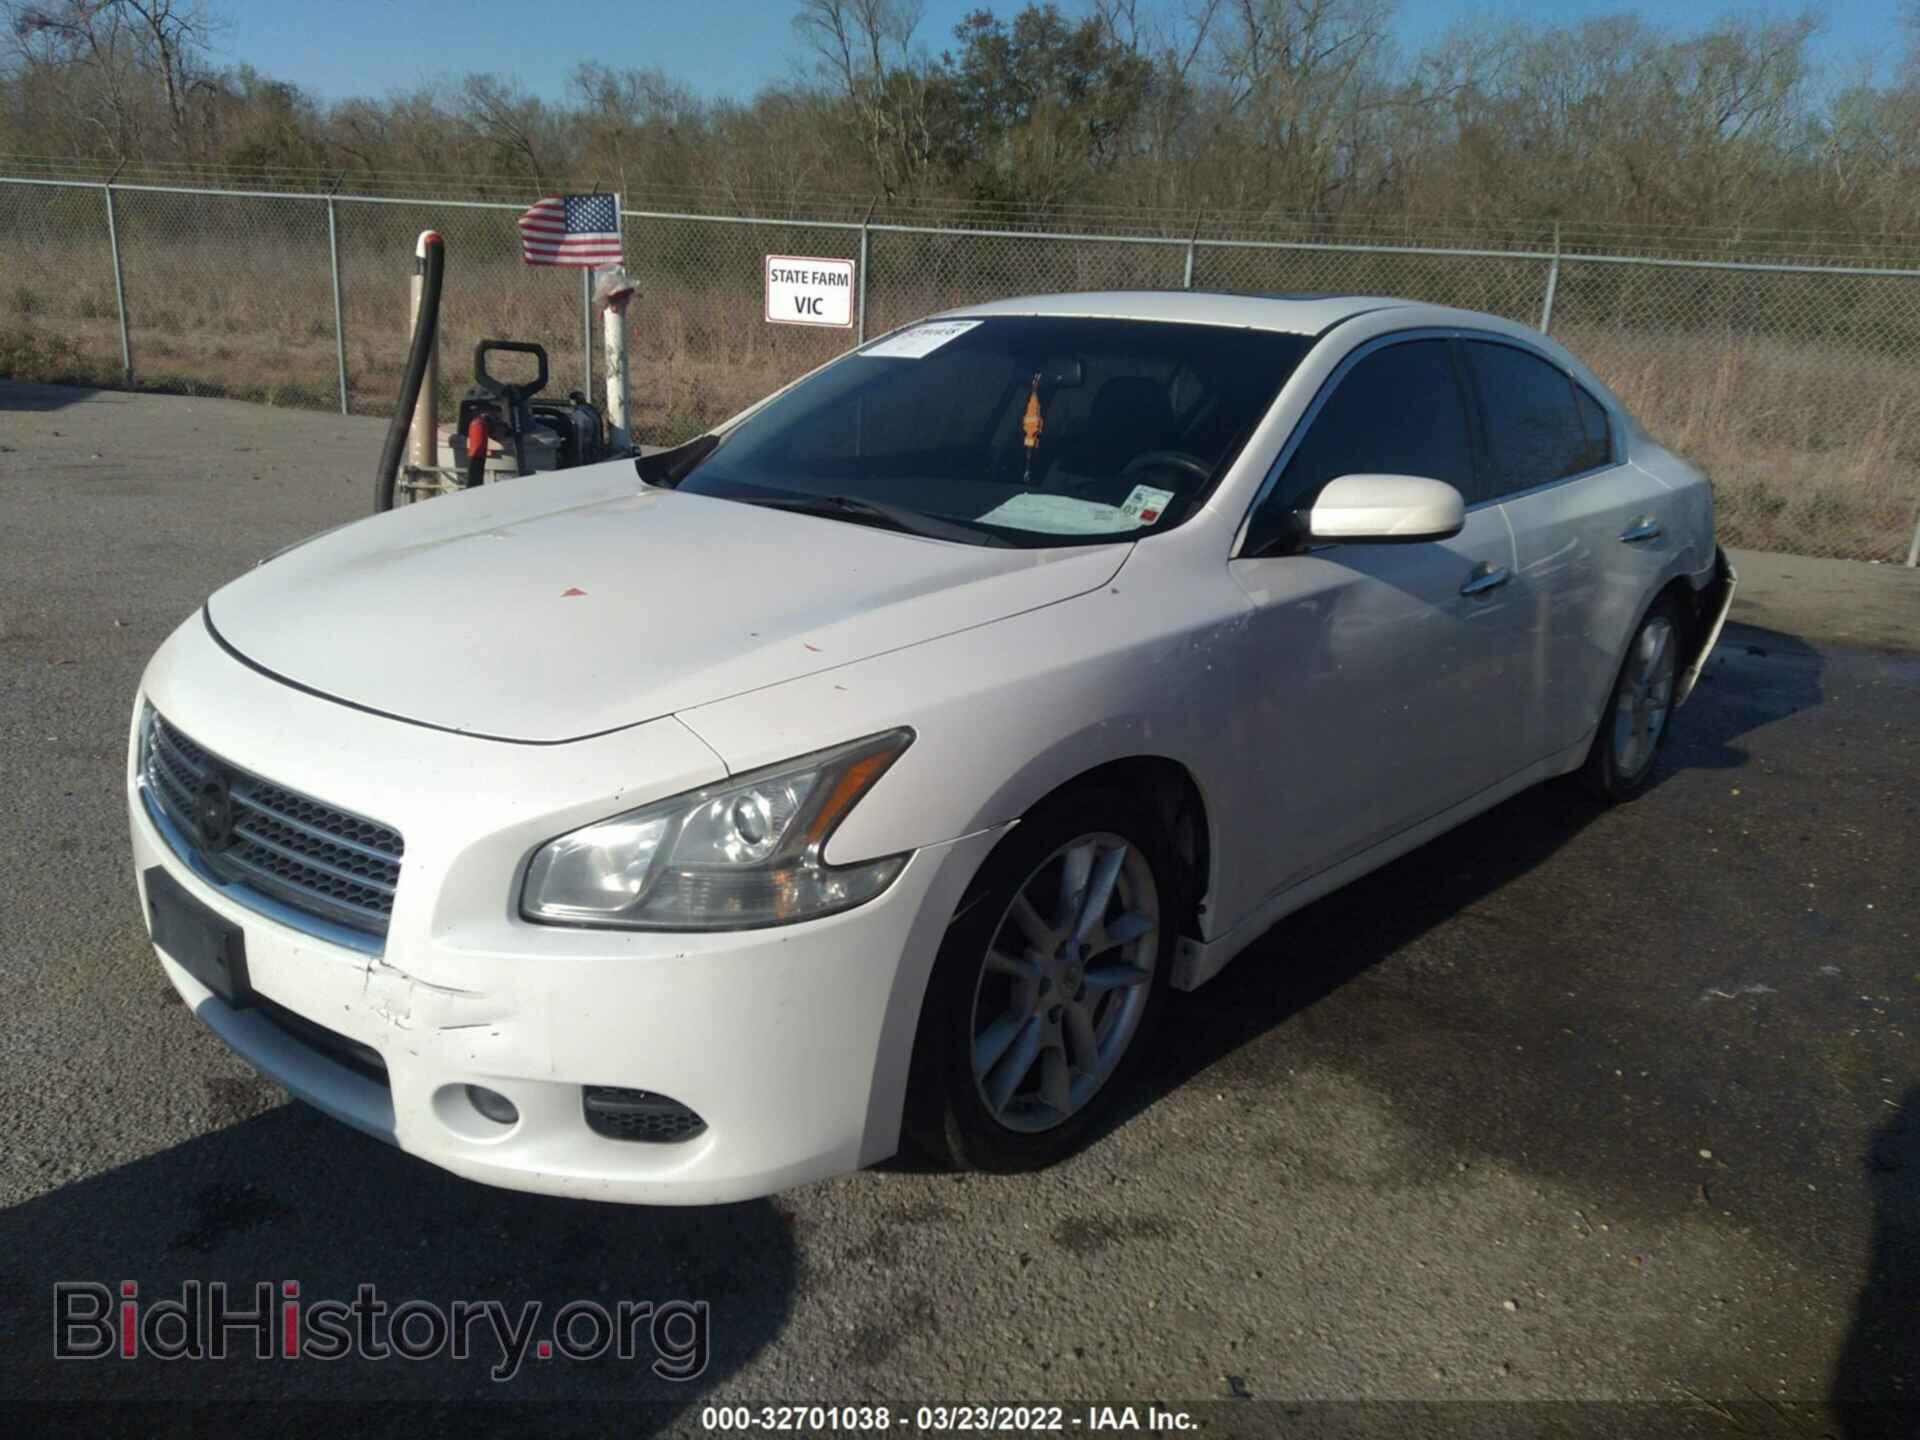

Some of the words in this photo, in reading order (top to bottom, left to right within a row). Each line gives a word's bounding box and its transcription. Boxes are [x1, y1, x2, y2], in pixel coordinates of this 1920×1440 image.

[771, 268, 809, 285] STATE
[812, 272, 849, 287] FARM
[794, 296, 824, 316] VIC
